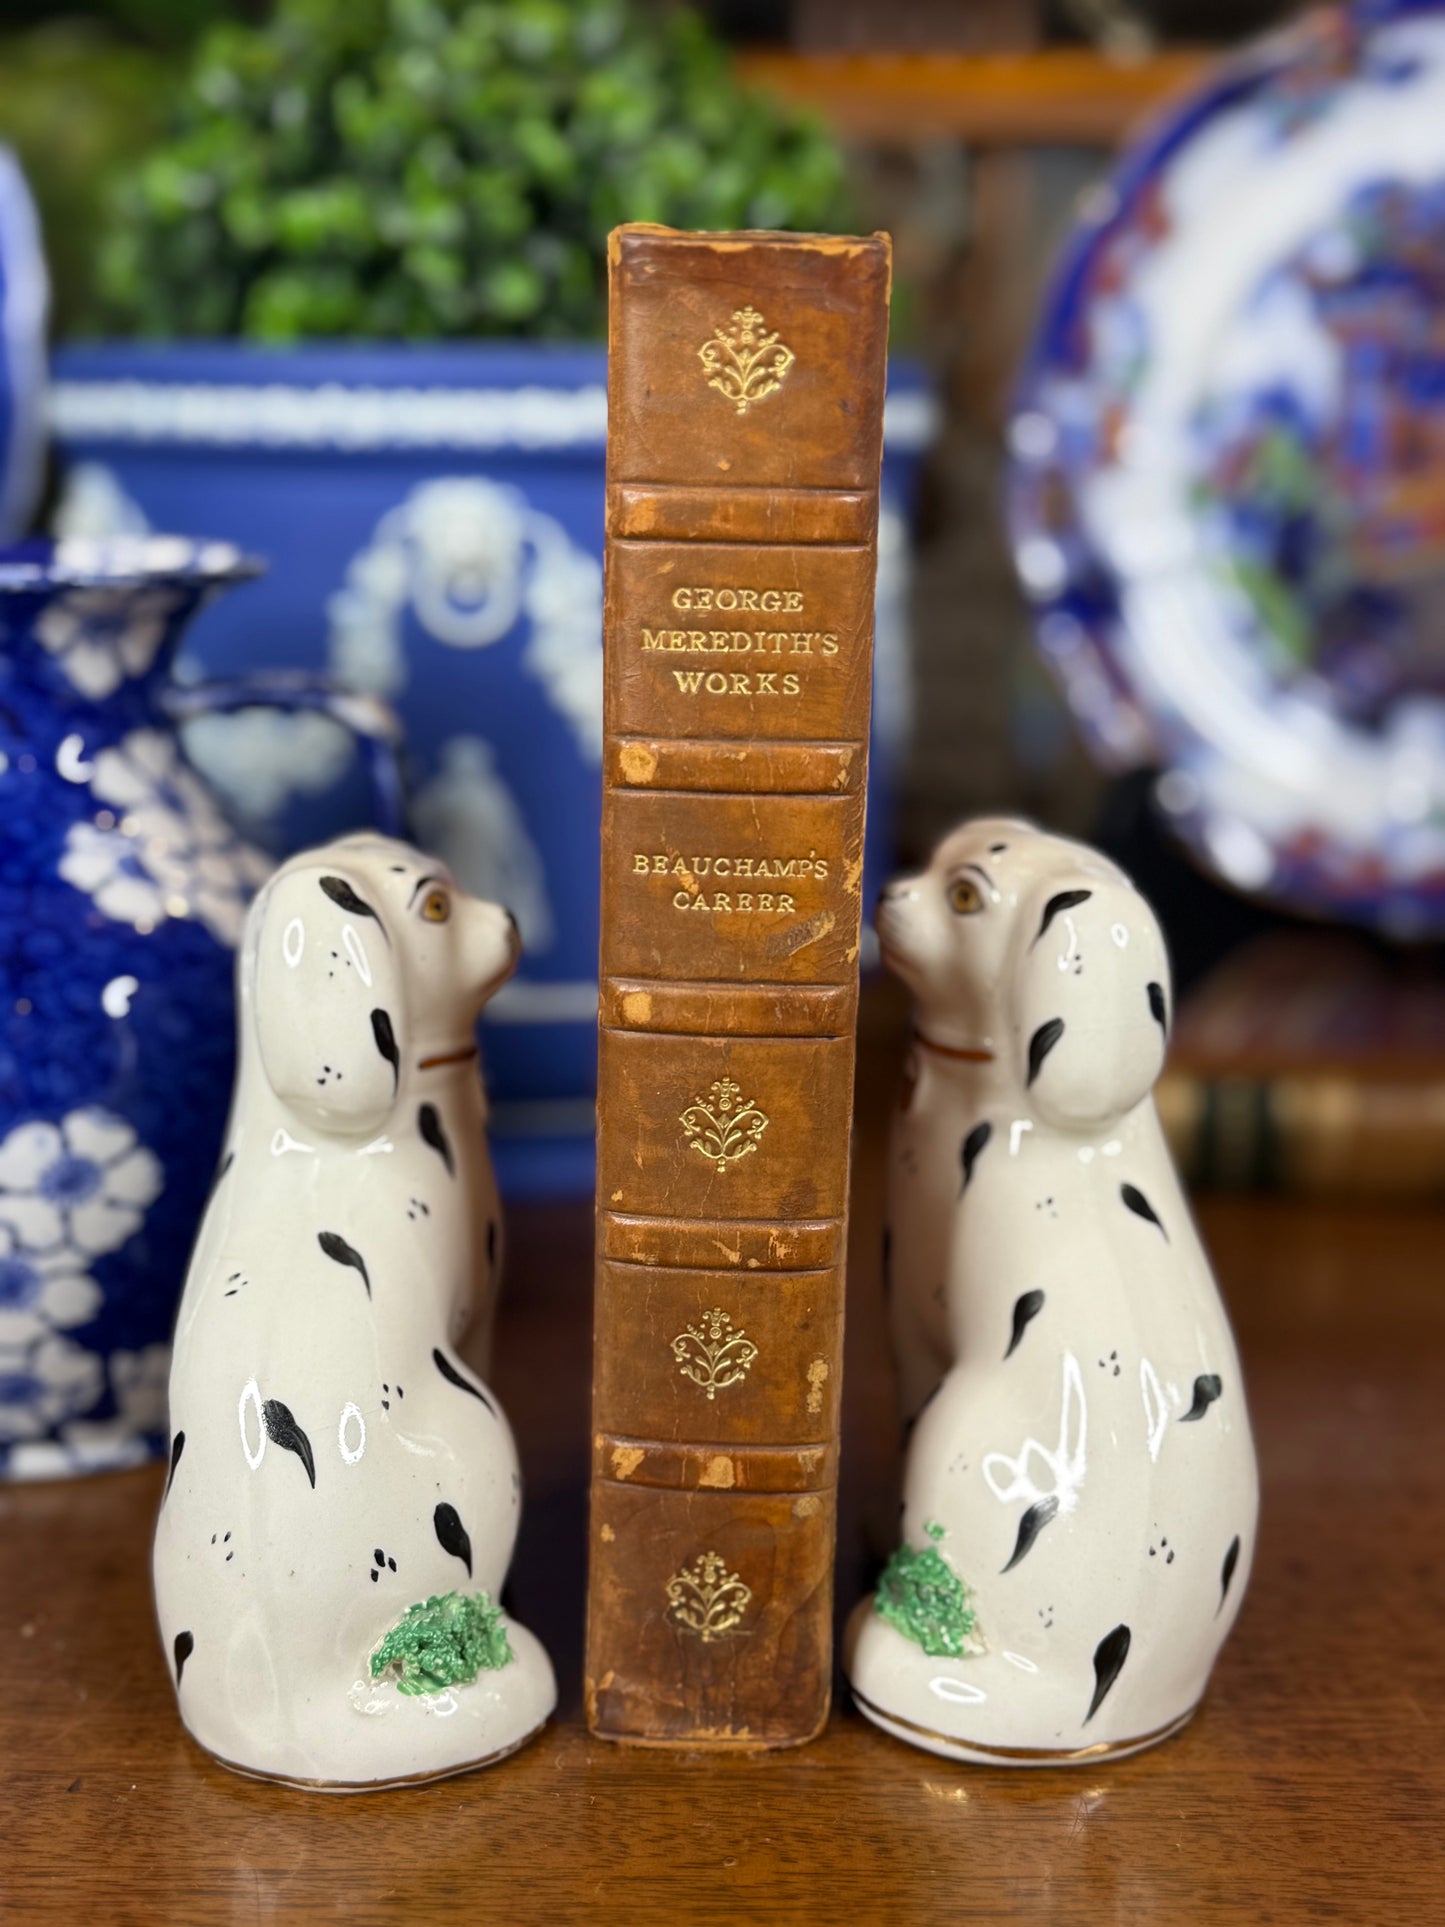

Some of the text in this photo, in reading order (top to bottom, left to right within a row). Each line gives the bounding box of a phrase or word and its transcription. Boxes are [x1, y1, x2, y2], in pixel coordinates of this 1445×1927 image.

[672, 587, 803, 612] GEORGE
[641, 628, 839, 655] MEREDITH'S
[672, 670, 800, 695] WORKS
[632, 850, 828, 878] BEAUCHAMP'S
[672, 891, 796, 913] CAREER
